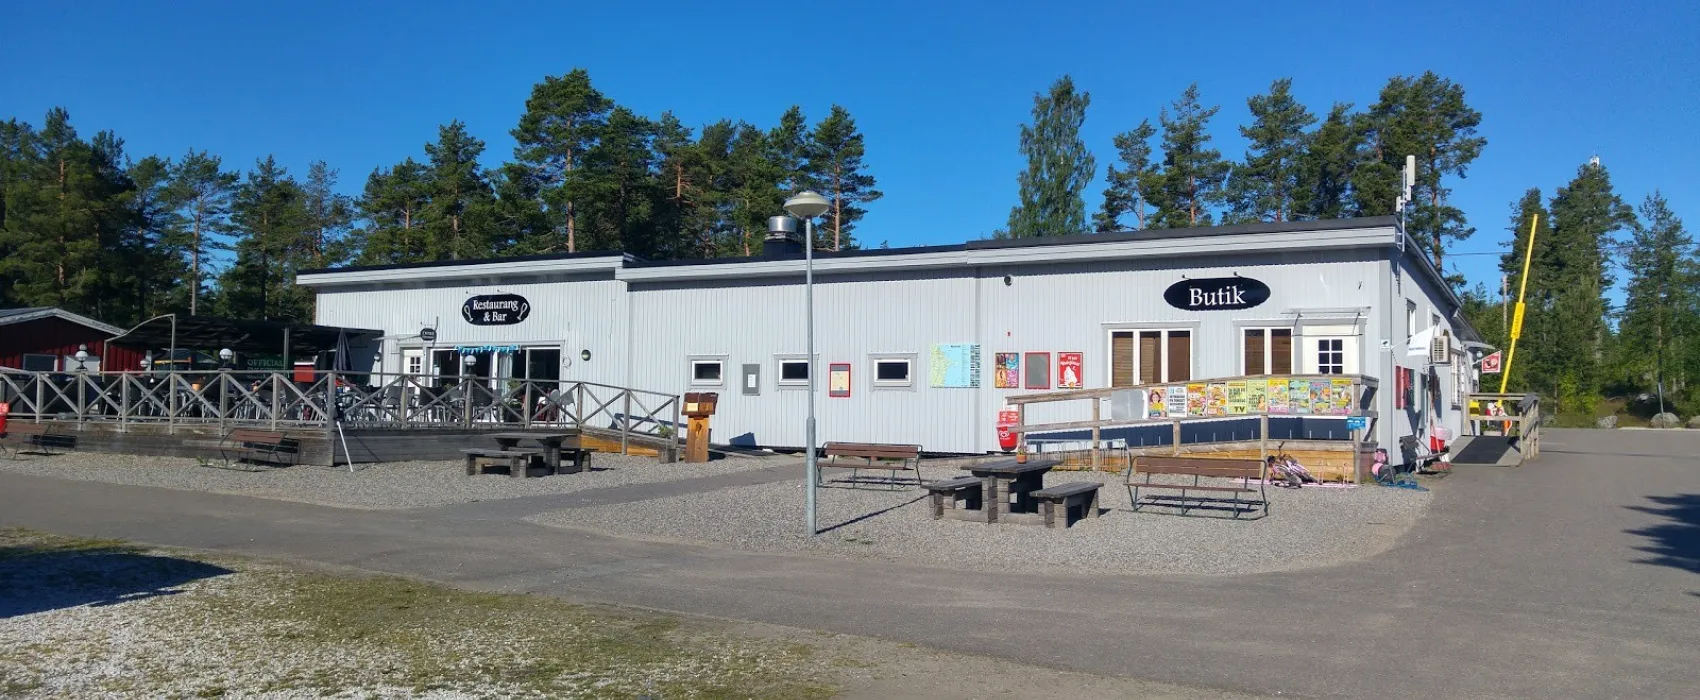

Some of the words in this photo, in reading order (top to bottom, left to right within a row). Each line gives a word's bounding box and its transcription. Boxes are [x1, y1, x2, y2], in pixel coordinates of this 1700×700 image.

[1189, 286, 1246, 306] Butik
[472, 300, 518, 312] Restaurang
[483, 311, 491, 322] &
[492, 312, 507, 322] Bar
[247, 358, 285, 367] OFFICIAL
